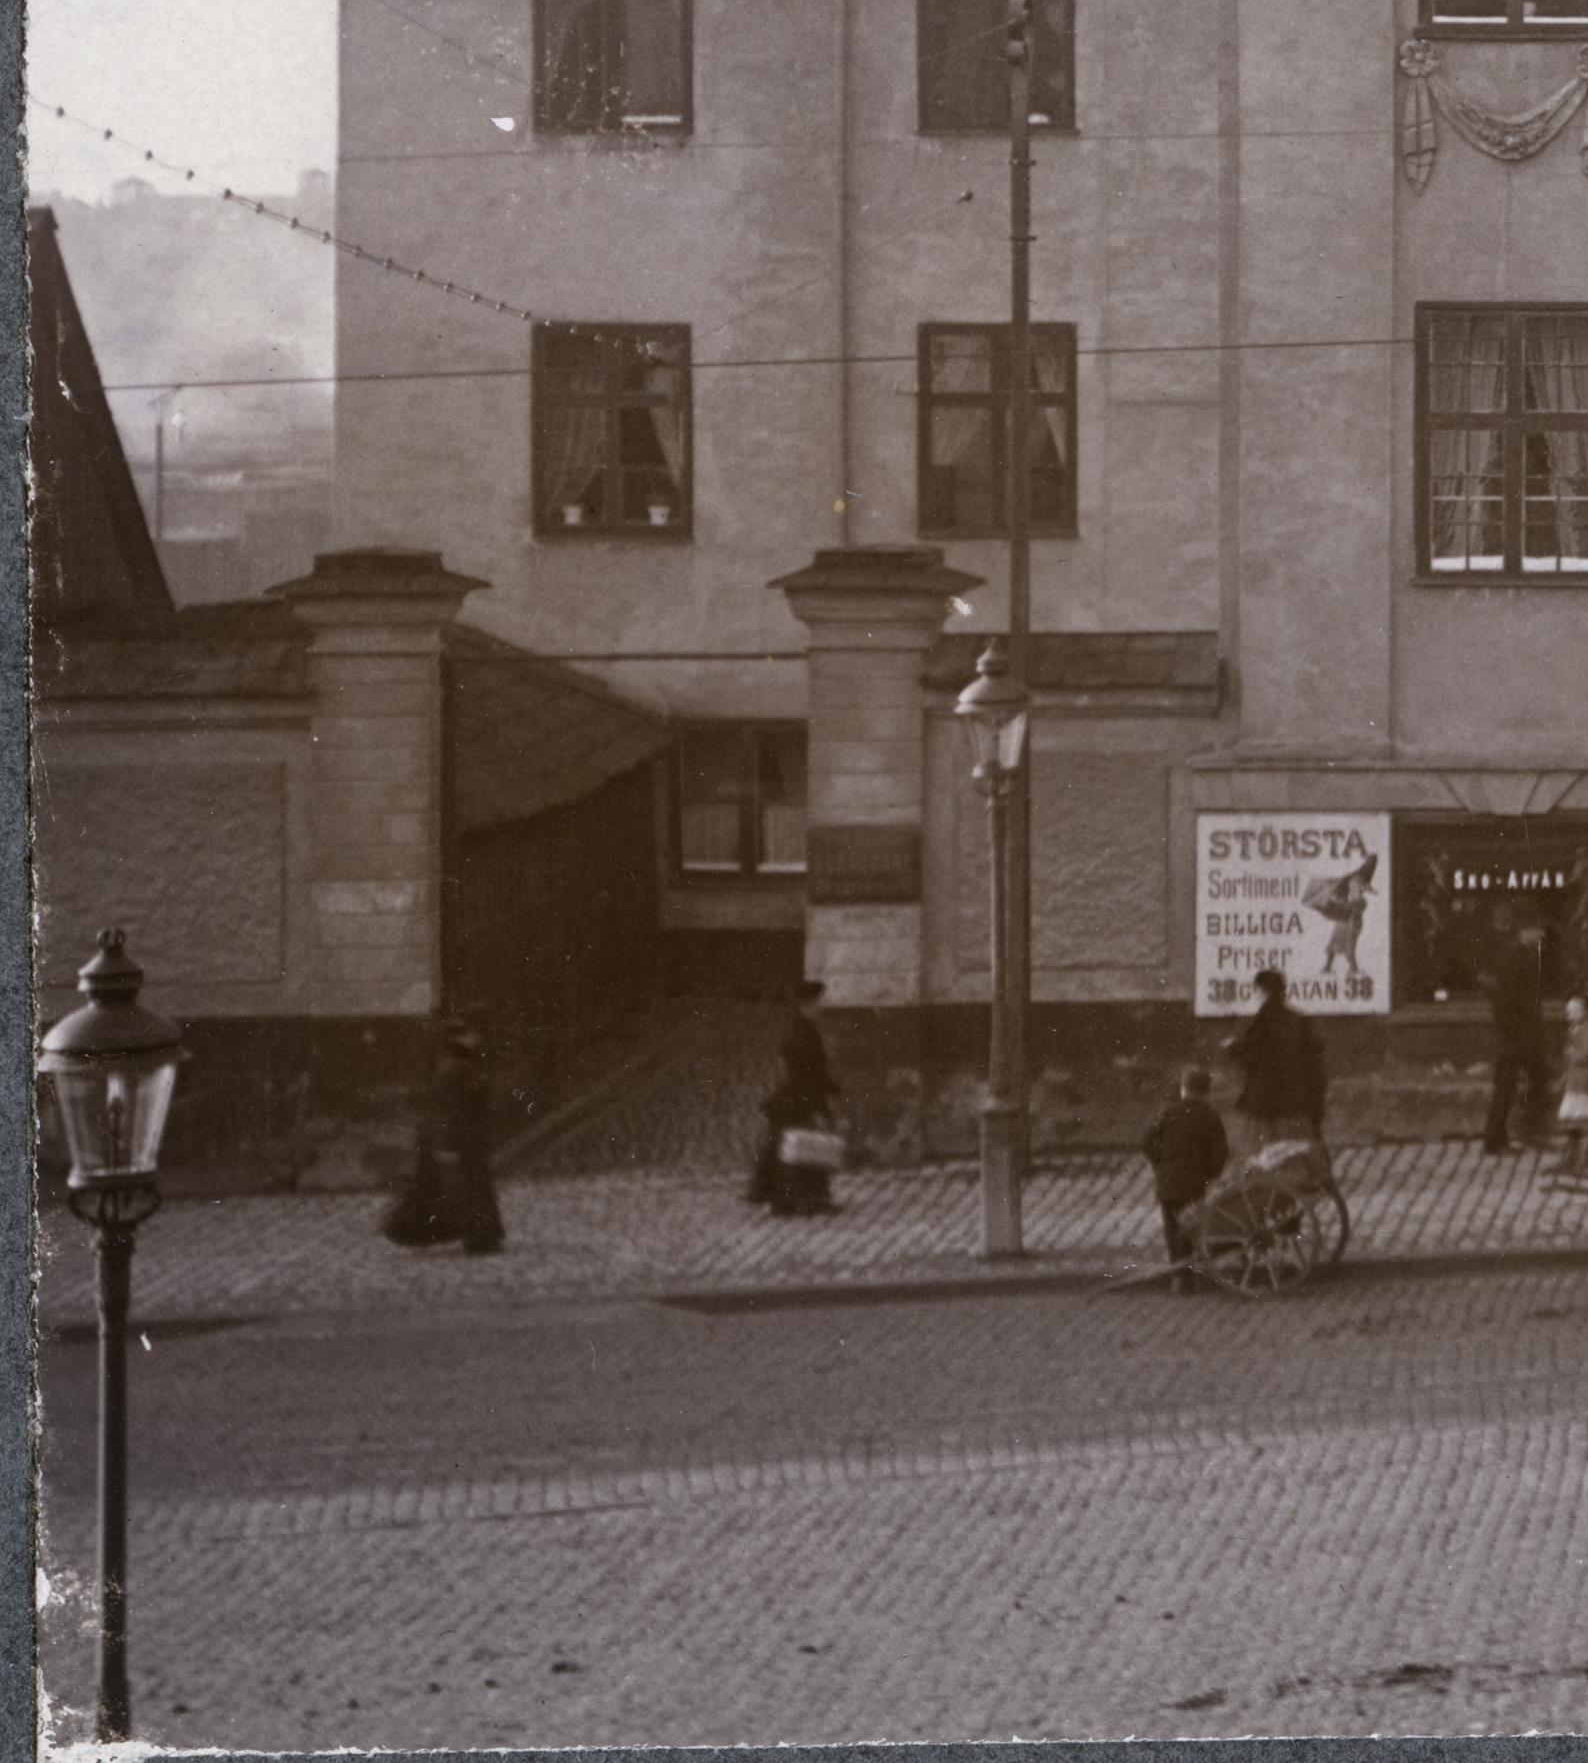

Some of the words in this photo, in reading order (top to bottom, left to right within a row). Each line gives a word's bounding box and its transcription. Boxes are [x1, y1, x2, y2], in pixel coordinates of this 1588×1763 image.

[1209, 825, 1368, 861] STÖRSTA
[1208, 870, 1300, 900] Sortiment
[1206, 912, 1304, 936] BILLIGA
[1218, 946, 1293, 970] Priser
[1208, 978, 1237, 1004] 38
[1344, 976, 1374, 1001] 38
